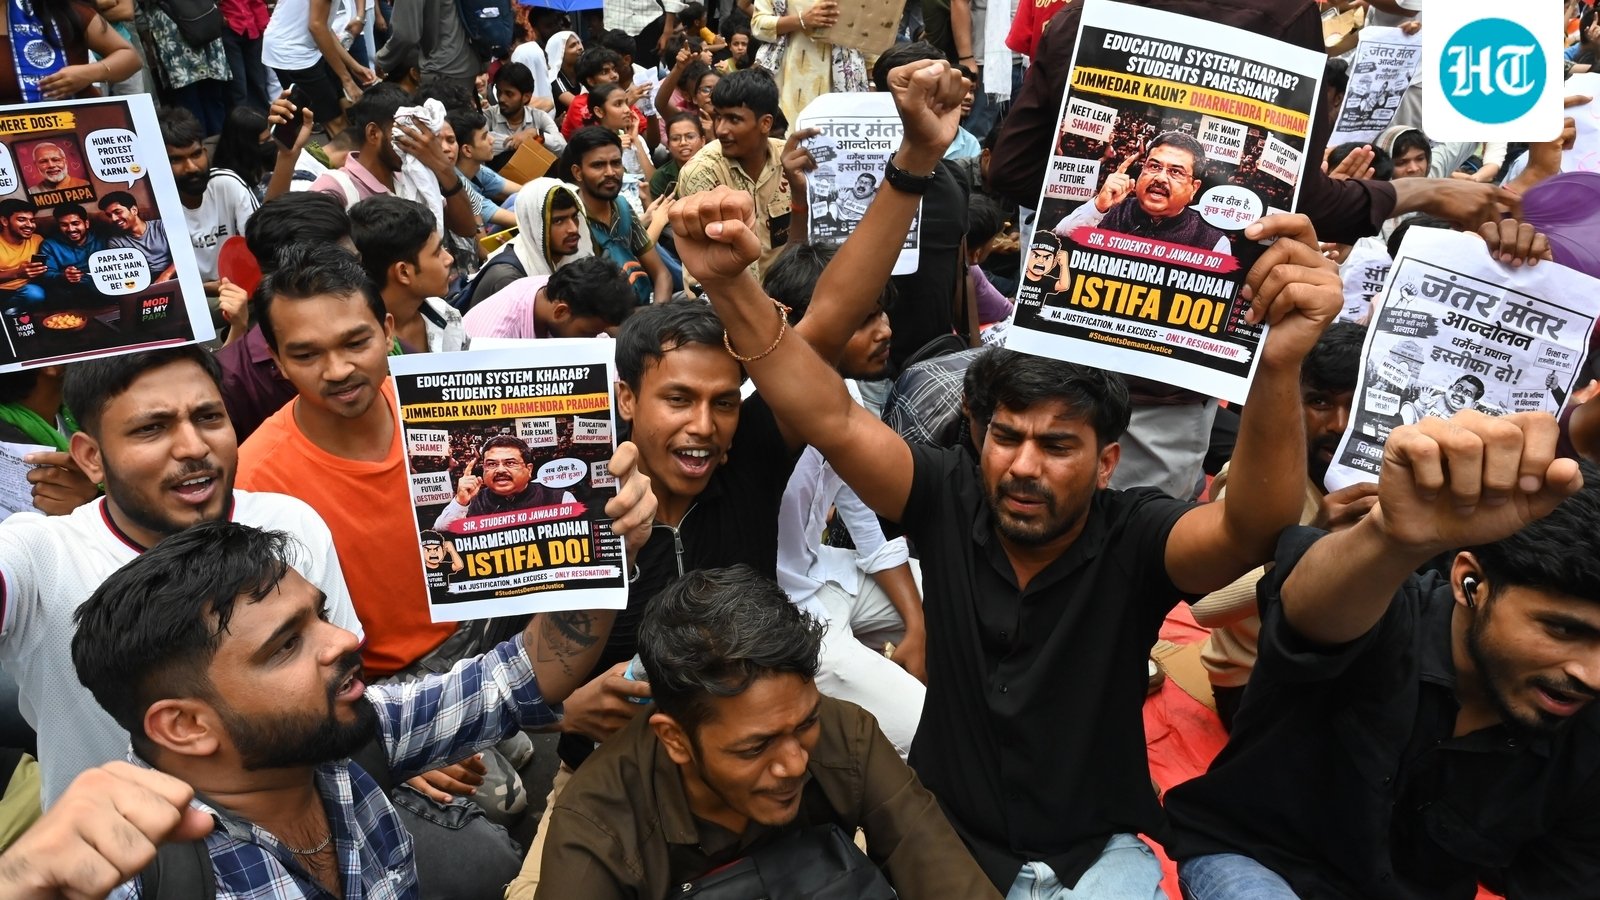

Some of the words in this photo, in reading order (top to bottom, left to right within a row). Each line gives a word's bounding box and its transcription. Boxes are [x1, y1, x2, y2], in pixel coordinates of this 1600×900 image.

[1370, 44, 1395, 58] जंतर
[1103, 33, 1184, 64] EDUCATION
[1185, 51, 1242, 75] SYSTEM
[1242, 64, 1300, 91] KHARAB?
[1126, 57, 1201, 85] STUDENTS
[1202, 72, 1279, 103] PARESHAN?
[1074, 71, 1142, 96] JIMMEDAR
[1143, 83, 1187, 104] KAUN?
[1190, 91, 1262, 121] DHARMENDRA
[1264, 110, 1308, 134] PRADHAN!
[1071, 104, 1092, 119] NEET
[1093, 110, 1113, 124] LEAK
[31, 115, 64, 129] DOST:
[1072, 119, 1105, 135] SHAME!
[1209, 121, 1220, 132] WE
[1221, 125, 1241, 137] WANT
[92, 137, 116, 146] HUME
[117, 135, 133, 144] KYA
[836, 137, 892, 150] आन्दोलन
[1203, 132, 1219, 143] FAIR
[1219, 136, 1241, 148] EXAMS
[98, 145, 133, 156] PROTEST
[1215, 146, 1239, 159] SCAMS!
[1270, 142, 1298, 162] EDUCATION
[101, 155, 135, 166] VROTEST
[838, 161, 875, 173] इस्तीफा
[1053, 161, 1076, 172] PAPER
[1077, 164, 1095, 174] LEAK
[1276, 156, 1287, 167] NOT
[101, 166, 129, 177] KARNA
[1262, 160, 1295, 180] CORRUPTION!
[1060, 174, 1086, 185] FUTURE
[34, 192, 63, 207] MODI
[65, 188, 94, 202] PAPA
[1049, 184, 1092, 197] DESTROYED!
[1212, 195, 1225, 204] सब
[1226, 196, 1242, 207] ठीक
[1204, 205, 1219, 216] कुछ
[1236, 212, 1255, 222] हुआ!
[98, 254, 118, 264] PAPA
[119, 252, 134, 262] SAB
[1088, 233, 1105, 247] SIR,
[1107, 236, 1152, 255] STUDENTS
[1152, 245, 1164, 256] KO
[1165, 248, 1204, 265] JAWAAB
[1205, 255, 1223, 269] DO!
[94, 264, 123, 274] JAANTE
[124, 261, 145, 270] HAIN,
[1070, 250, 1166, 287] DHARMENDRA
[1167, 269, 1235, 300] PRADHAN
[102, 273, 123, 282] CHILL
[124, 271, 140, 280] KAR
[111, 282, 123, 290] BE!
[143, 297, 169, 308] MODI
[154, 305, 168, 313] MY
[1070, 274, 1162, 321] ISTIFA
[1167, 295, 1226, 334] DO!
[1421, 274, 1501, 319] जंतर
[1501, 301, 1568, 341] मंतर
[16, 323, 34, 331] MODI
[18, 329, 36, 337] PAPA
[1051, 311, 1062, 320] NA
[1063, 314, 1115, 332] JUSTIFICATION,
[1115, 323, 1126, 332] NA
[1127, 326, 1158, 339] EXCUSES
[1165, 333, 1186, 344] ONLY
[1186, 338, 1239, 358] RESIGNATION!
[1442, 311, 1535, 351] आन्दोलन
[1089, 332, 1173, 355] #StudentsDemandJustice
[1484, 347, 1513, 363] प्रधान
[1431, 345, 1493, 376] इस्तीफा
[1495, 364, 1523, 385] दो!
[417, 374, 483, 389] EDUCATION
[486, 371, 536, 386] SYSTEM
[537, 368, 591, 383] KHARAB?
[442, 386, 503, 401] STUDENTS
[506, 382, 574, 397] PARESHAN?
[405, 405, 459, 420] JIMMEDAR
[462, 404, 497, 417] KAUN?
[501, 400, 565, 416] DHARMENDRA
[567, 397, 609, 411] PRADHAN!
[411, 434, 428, 442] NEET
[430, 434, 446, 442] LEAK
[416, 444, 443, 452] SHAME!
[1356, 441, 1384, 459] शिक्षा
[413, 477, 432, 486] PAPER
[433, 476, 447, 484] LEAK
[421, 485, 443, 493] FUTURE
[417, 493, 452, 503] DESTROYED!
[463, 521, 478, 532] SIR,
[480, 515, 516, 529] STUDENTS
[518, 513, 528, 523] KO
[529, 510, 559, 522] JAWAAB
[560, 506, 573, 516] DO!
[455, 527, 536, 552] DHARMENDRA
[538, 521, 590, 540] PRADHAN
[466, 544, 544, 577] ISTIFA
[548, 539, 591, 566] DO!
[469, 579, 513, 591] JUSTIFICATION,
[514, 577, 522, 585] NA
[523, 573, 548, 584] EXCUSES
[555, 570, 571, 578] ONLY
[572, 569, 612, 577] RESIGNATION!
[495, 583, 565, 597] #StudentsDemandJustice
